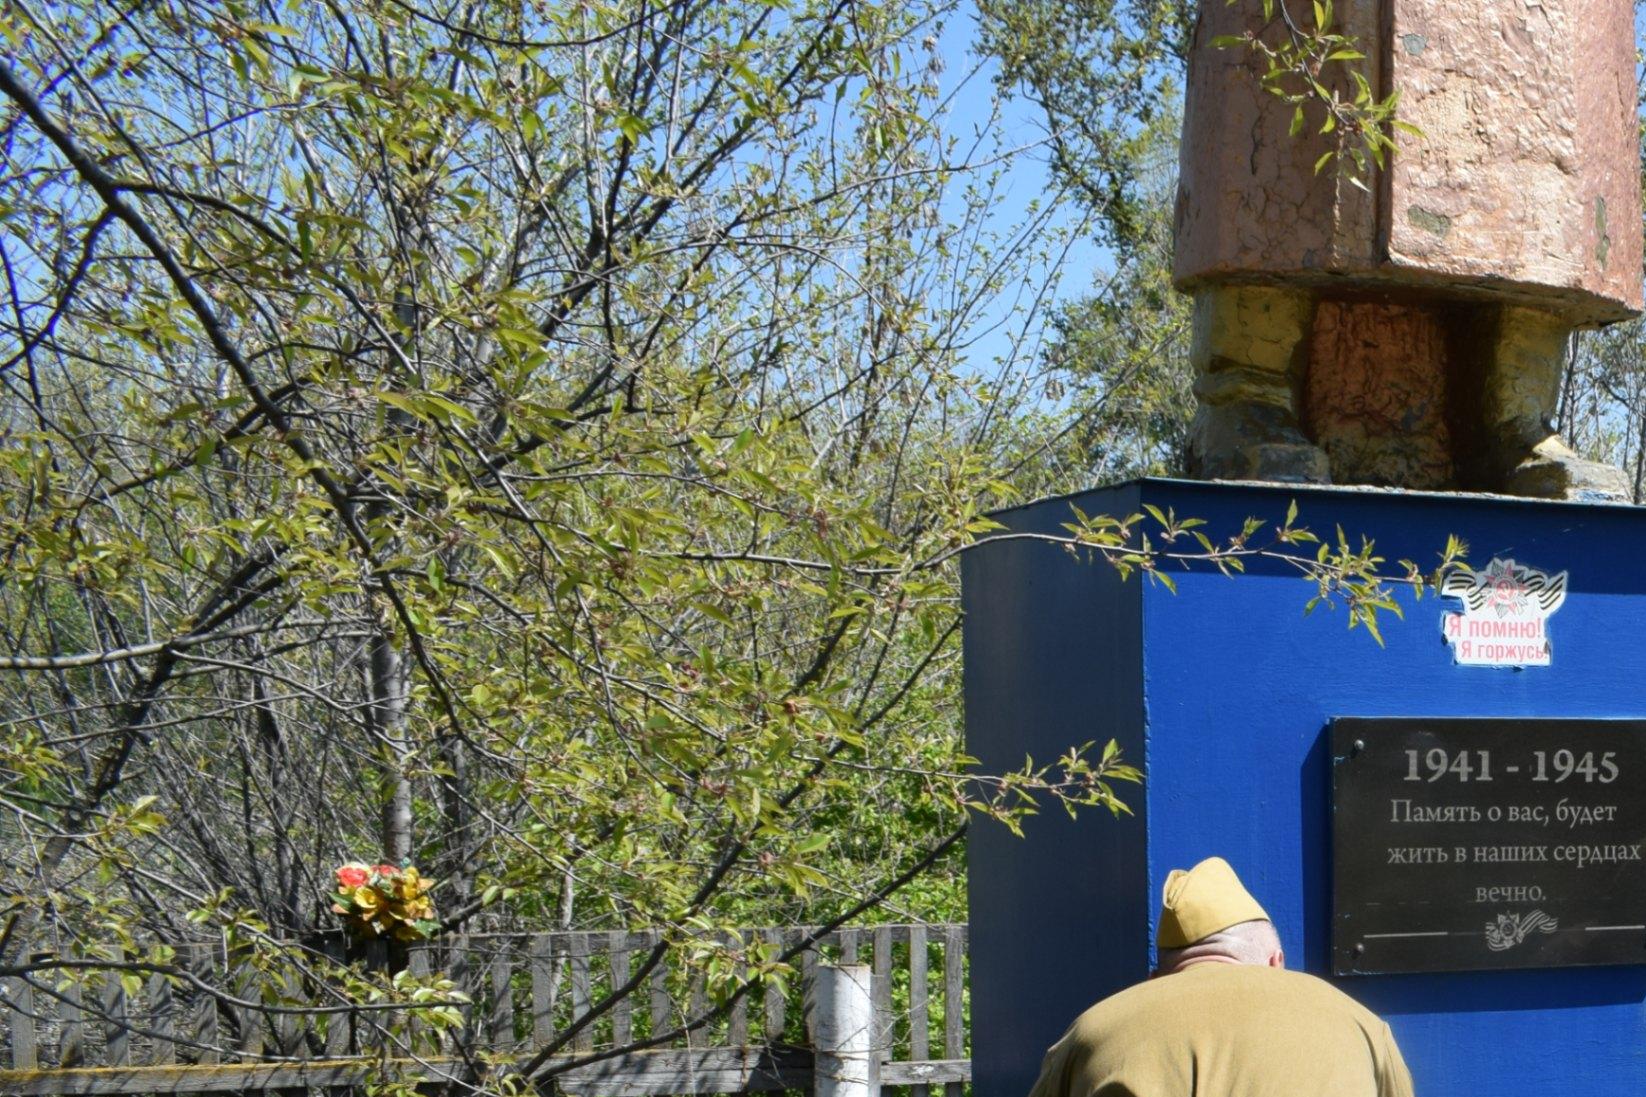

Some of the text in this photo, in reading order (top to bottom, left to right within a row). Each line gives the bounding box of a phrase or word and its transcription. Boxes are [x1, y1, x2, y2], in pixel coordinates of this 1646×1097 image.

[1448, 615, 1541, 639] Я помню!
[1461, 640, 1472, 658] Я
[1403, 748, 1493, 783] 1941
[1532, 748, 1620, 783] 1945
[1390, 798, 1617, 829] Память о вас, будет
[1387, 844, 1642, 868] жить в наших сердцах
[1476, 885, 1547, 902] вечно.
